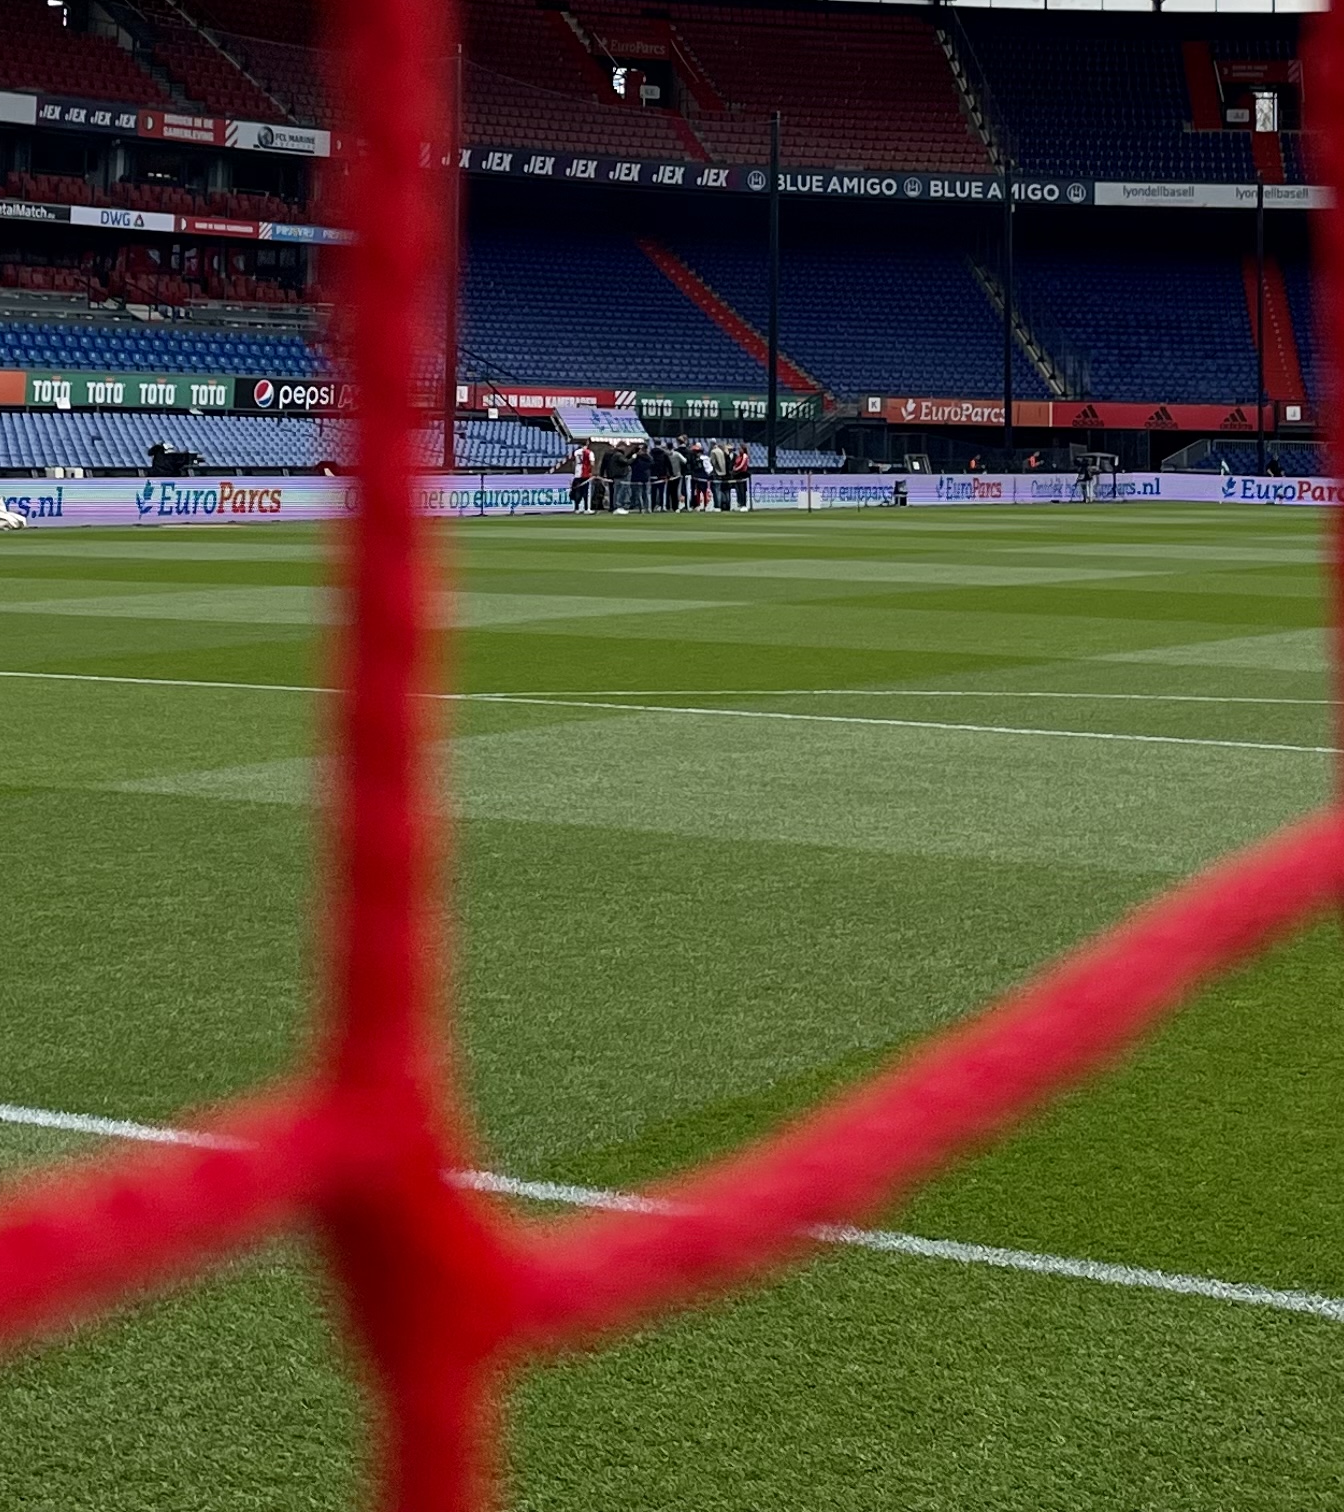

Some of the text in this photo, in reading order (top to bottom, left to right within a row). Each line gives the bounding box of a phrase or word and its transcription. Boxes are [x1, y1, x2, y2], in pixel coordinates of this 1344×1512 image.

[39, 104, 61, 121] JEX
[65, 107, 87, 123] JEX
[90, 109, 112, 126] JEX
[115, 112, 137, 129] JEX
[481, 151, 514, 173] JEX
[523, 154, 556, 176] JEX
[565, 158, 598, 179] JEX
[608, 162, 642, 183] JEX
[652, 165, 685, 186] JEX
[696, 168, 730, 188] JEX
[777, 174, 898, 196] BLUE AMIGO
[929, 181, 983, 199] BLUE
[1235, 187, 1309, 200] lyonellbasell
[100, 210, 131, 228] DWG
[32, 379, 72, 402] TOTO
[86, 381, 125, 404] TOTO
[138, 383, 177, 405] TOTO
[190, 384, 227, 407] TOTO
[278, 383, 336, 410] pepsi
[640, 398, 673, 418] TOTO
[686, 399, 720, 418] TOTO
[157, 481, 283, 517] EuroParcs
[945, 477, 1002, 500] EuroParcs
